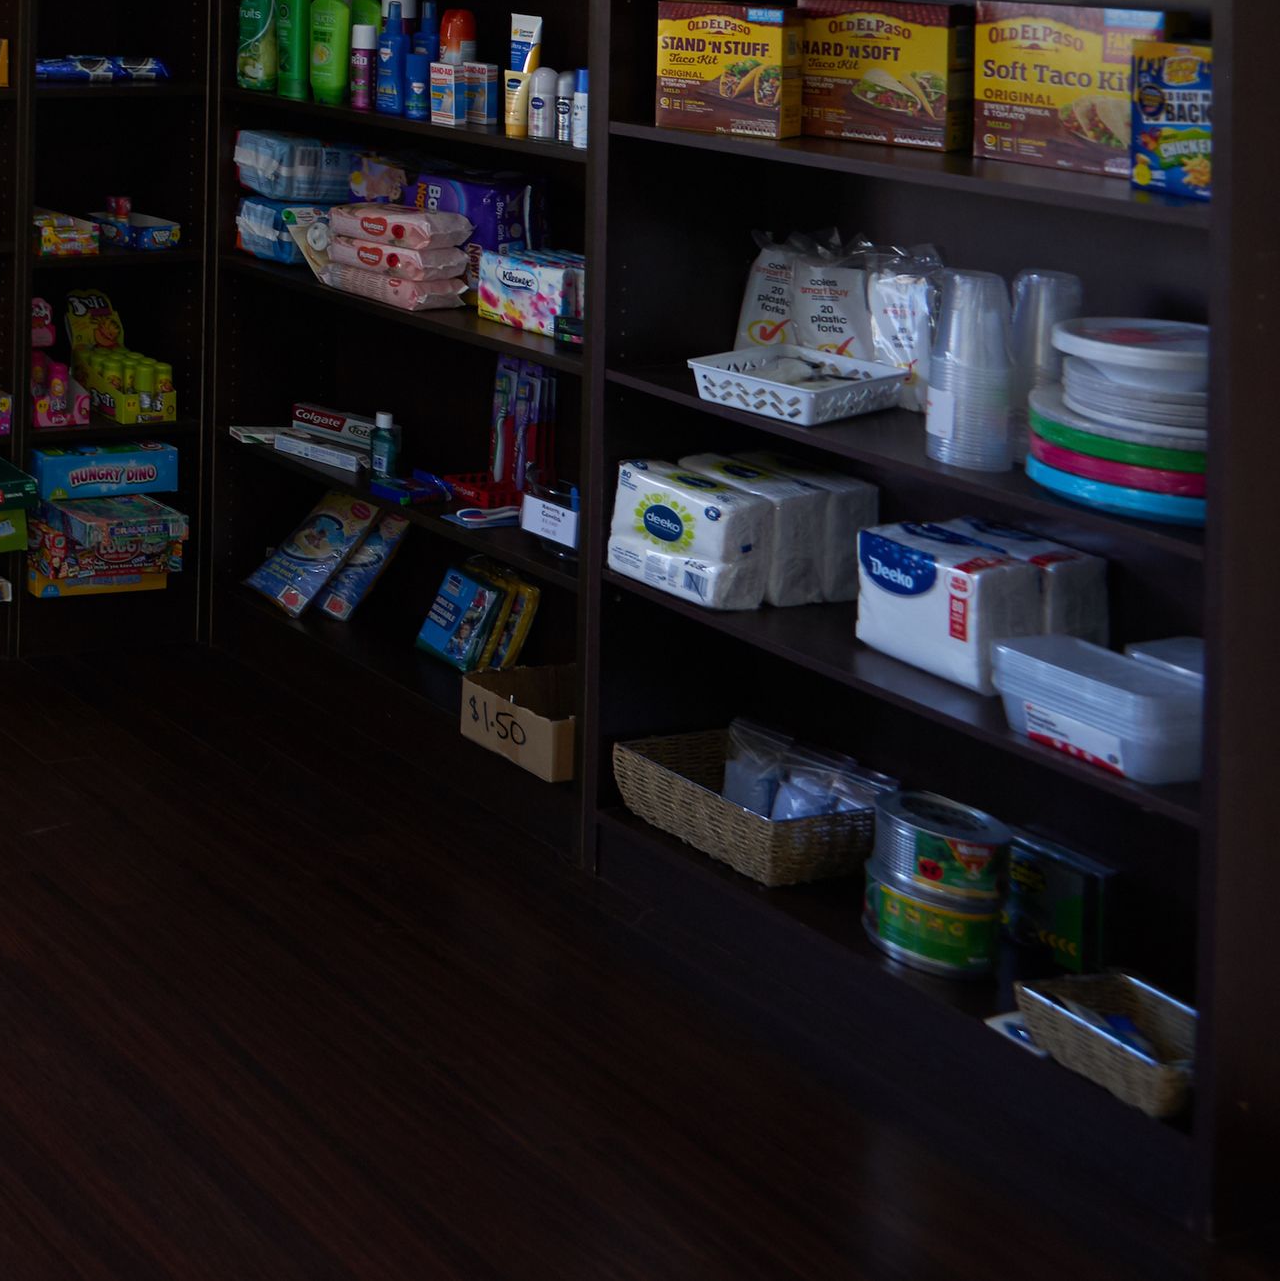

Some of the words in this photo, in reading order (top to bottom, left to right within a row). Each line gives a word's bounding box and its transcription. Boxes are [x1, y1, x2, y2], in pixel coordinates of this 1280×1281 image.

[688, 20, 708, 31] OLD
[710, 19, 721, 29] EL
[828, 20, 854, 34] OLD
[857, 19, 874, 31] EL
[988, 27, 1017, 44] OLD
[1020, 24, 1041, 41] EL
[661, 36, 706, 52] STAND
[724, 40, 769, 57] STUFF
[802, 40, 843, 57] HARD
[862, 45, 900, 61] SOFT
[669, 53, 695, 63] Taco
[697, 54, 719, 65] Kit
[808, 58, 835, 69] Taco
[837, 59, 859, 70] Kit
[431, 66, 453, 75] BAND-AID
[661, 69, 704, 78] ORIGINAL
[983, 59, 1027, 82] Soft
[1033, 64, 1092, 88] Taco
[983, 88, 1055, 106] ORIGINAL
[991, 110, 1026, 121] TOMATO
[502, 270, 532, 287] Kleenex
[809, 278, 838, 287] coles
[771, 286, 784, 295] 20
[757, 294, 790, 307] plastic
[761, 303, 786, 315] forks
[820, 305, 834, 314] 20
[810, 313, 847, 324] plastic
[817, 324, 844, 334] forks
[295, 408, 341, 429] Colgate
[70, 467, 121, 486] HUNGRY
[126, 466, 156, 482] DINO
[645, 511, 680, 533] deeko
[868, 555, 914, 590] Deeko
[469, 695, 526, 746] $1.50
